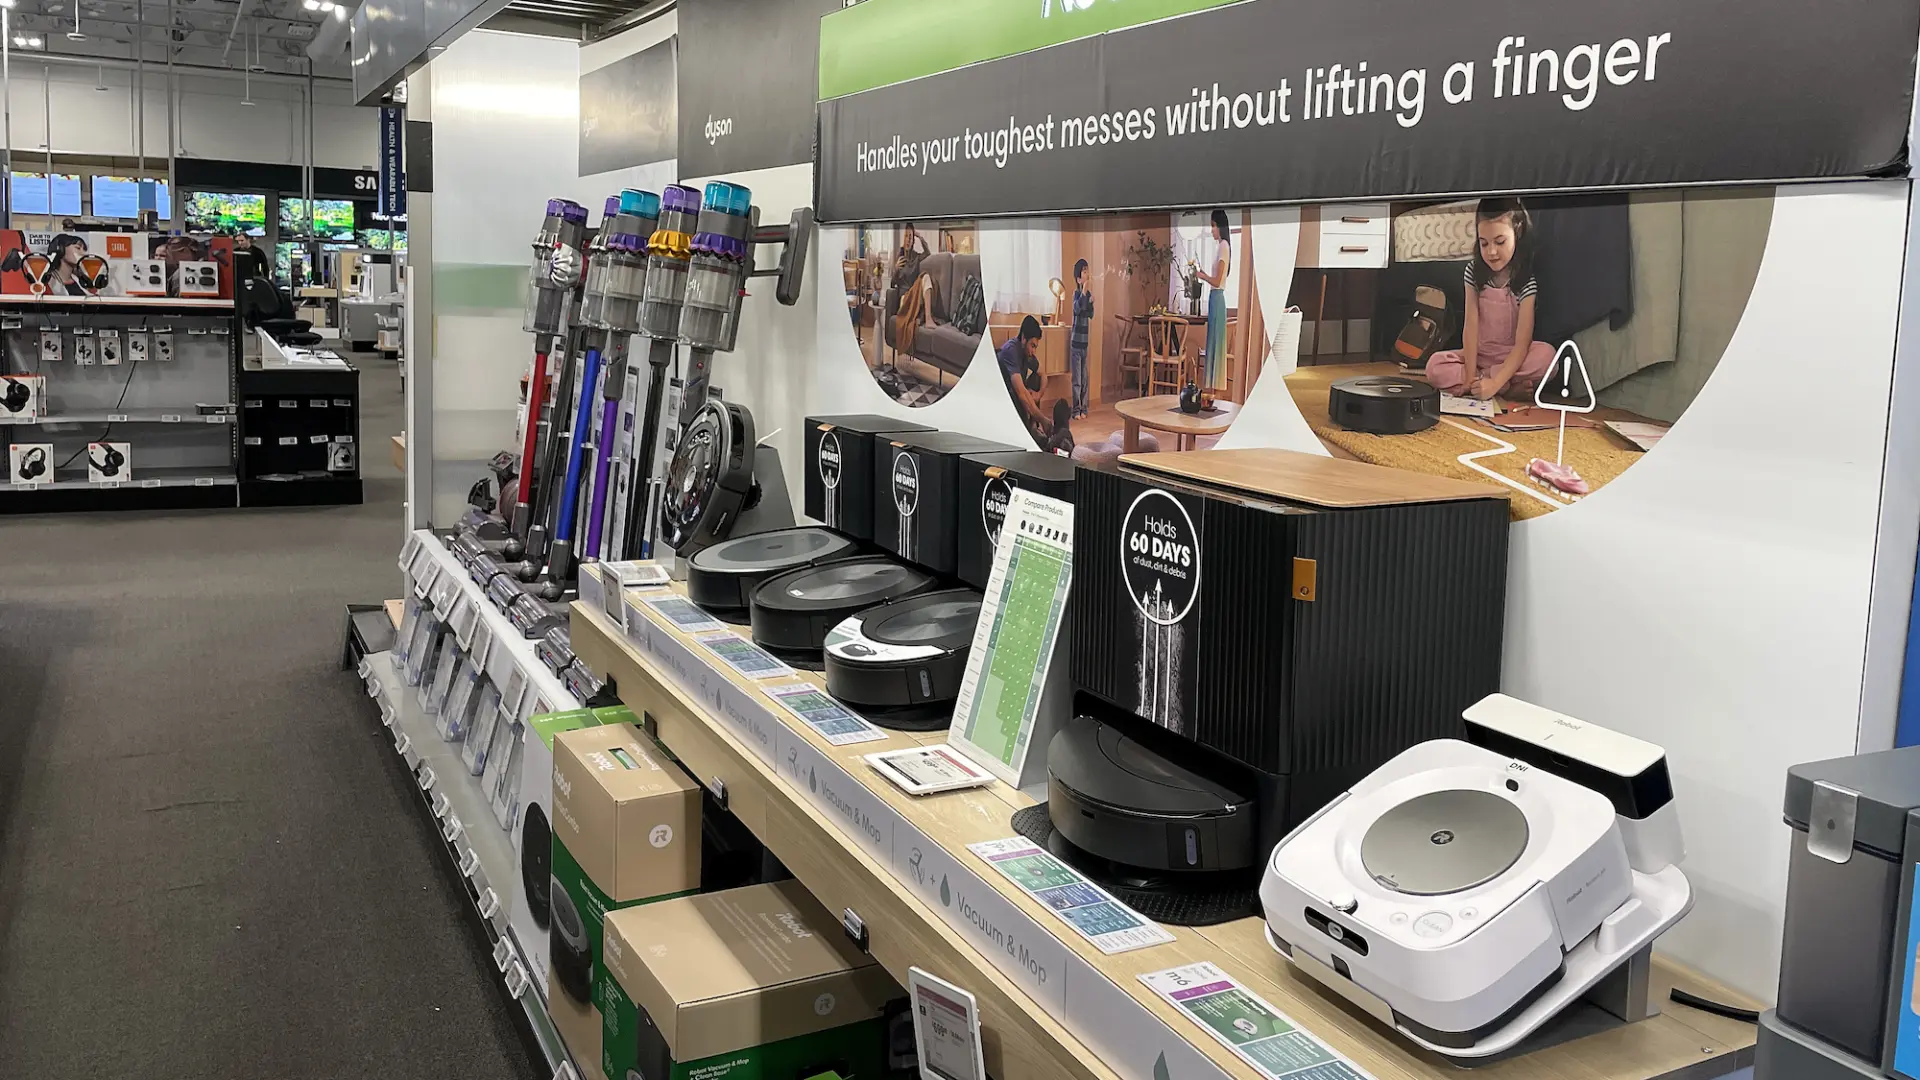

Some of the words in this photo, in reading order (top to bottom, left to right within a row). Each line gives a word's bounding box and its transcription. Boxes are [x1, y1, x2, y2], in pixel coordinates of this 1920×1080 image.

[857, 136, 917, 172] Handles
[921, 135, 959, 175] your
[965, 114, 1054, 168] toughest
[1061, 107, 1156, 148] messes
[1165, 79, 1291, 136] without
[1303, 61, 1427, 128] lifting
[1442, 60, 1474, 104] a
[1492, 32, 1671, 110] finger
[705, 114, 732, 145] dyson
[986, 499, 995, 511] 60
[1024, 497, 1045, 511] Compare
[1044, 503, 1064, 517] Products
[1145, 514, 1177, 539] Holds
[1130, 532, 1149, 554] 60
[1152, 537, 1191, 567] DAYS
[1509, 762, 1529, 772] DNI
[820, 779, 852, 820] Vacuum
[853, 808, 861, 824] &
[862, 813, 881, 843] Mop
[957, 892, 1004, 947] Vacuum
[1007, 935, 1015, 958] &
[1018, 944, 1047, 986] Mop
[1166, 971, 1192, 986] m6
